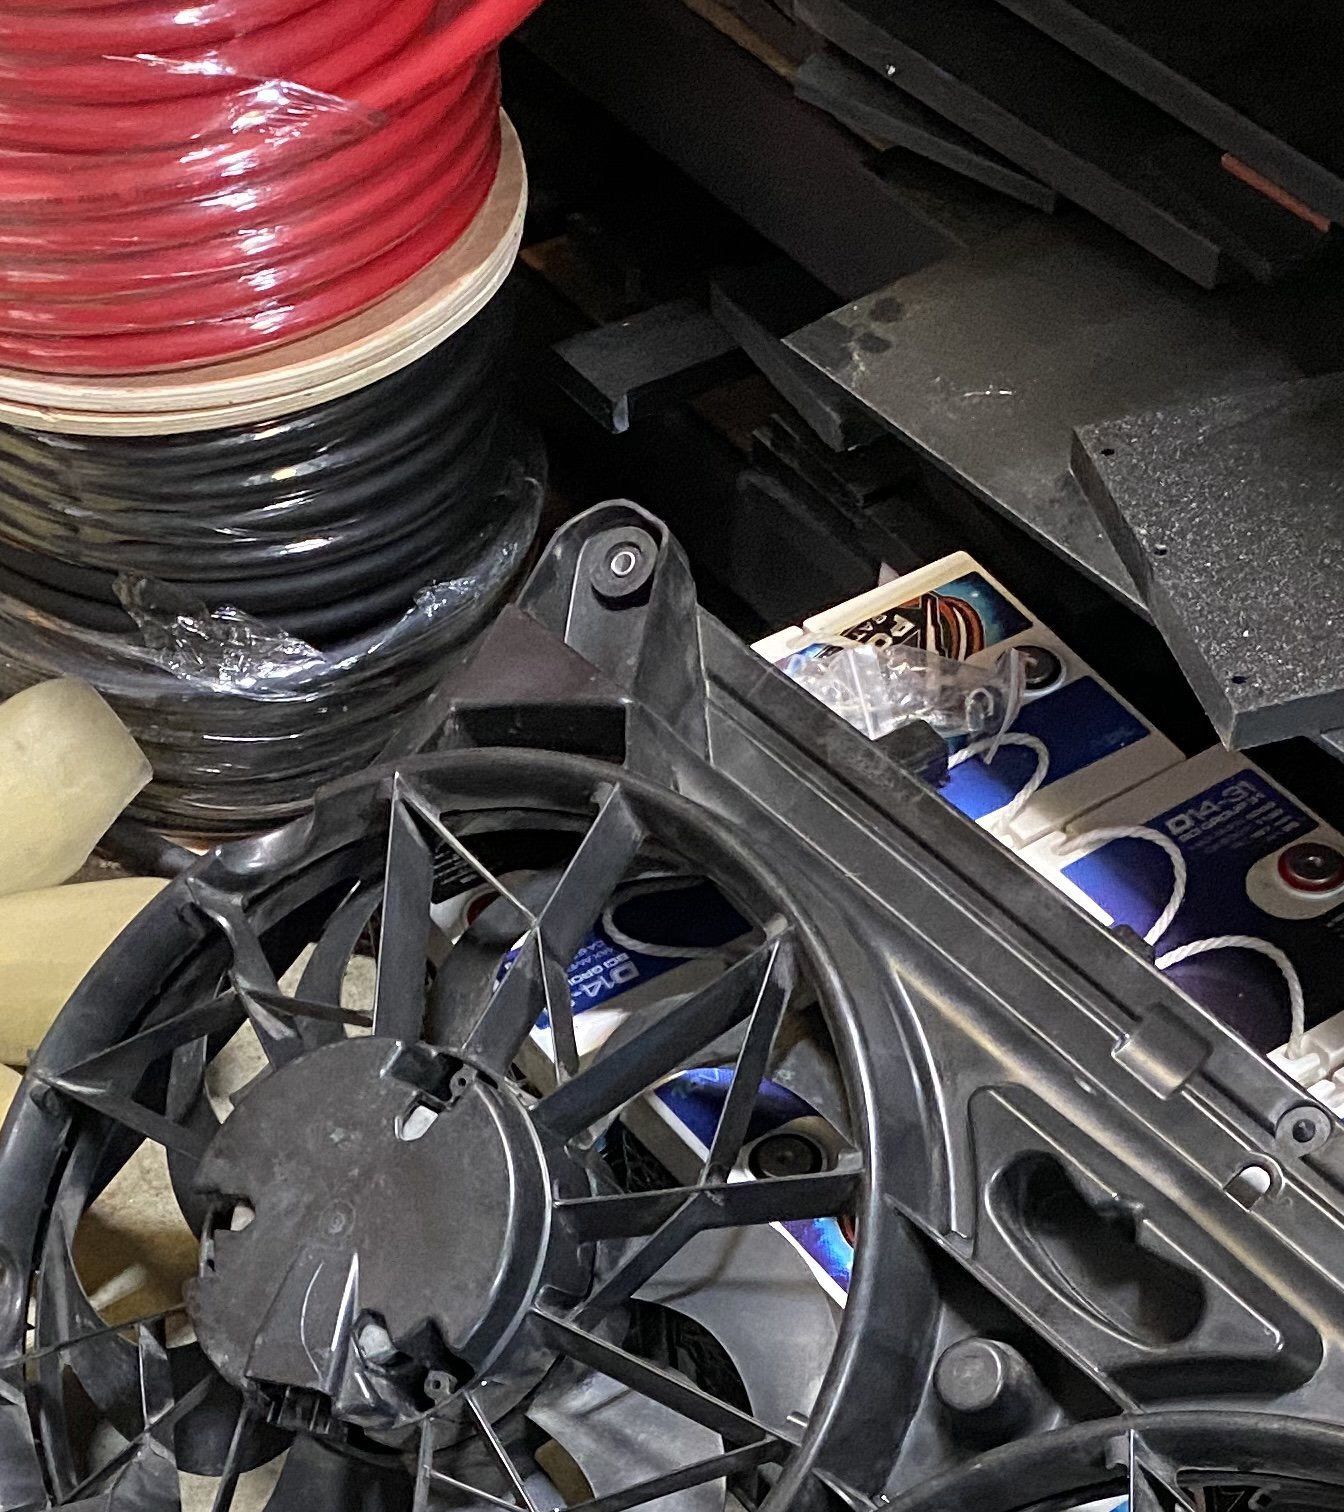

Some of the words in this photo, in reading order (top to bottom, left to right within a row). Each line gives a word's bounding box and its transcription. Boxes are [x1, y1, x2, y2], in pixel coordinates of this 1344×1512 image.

[1165, 780, 1257, 836] D14-31
[567, 964, 604, 986] GRO
[570, 960, 641, 1007] D14-
